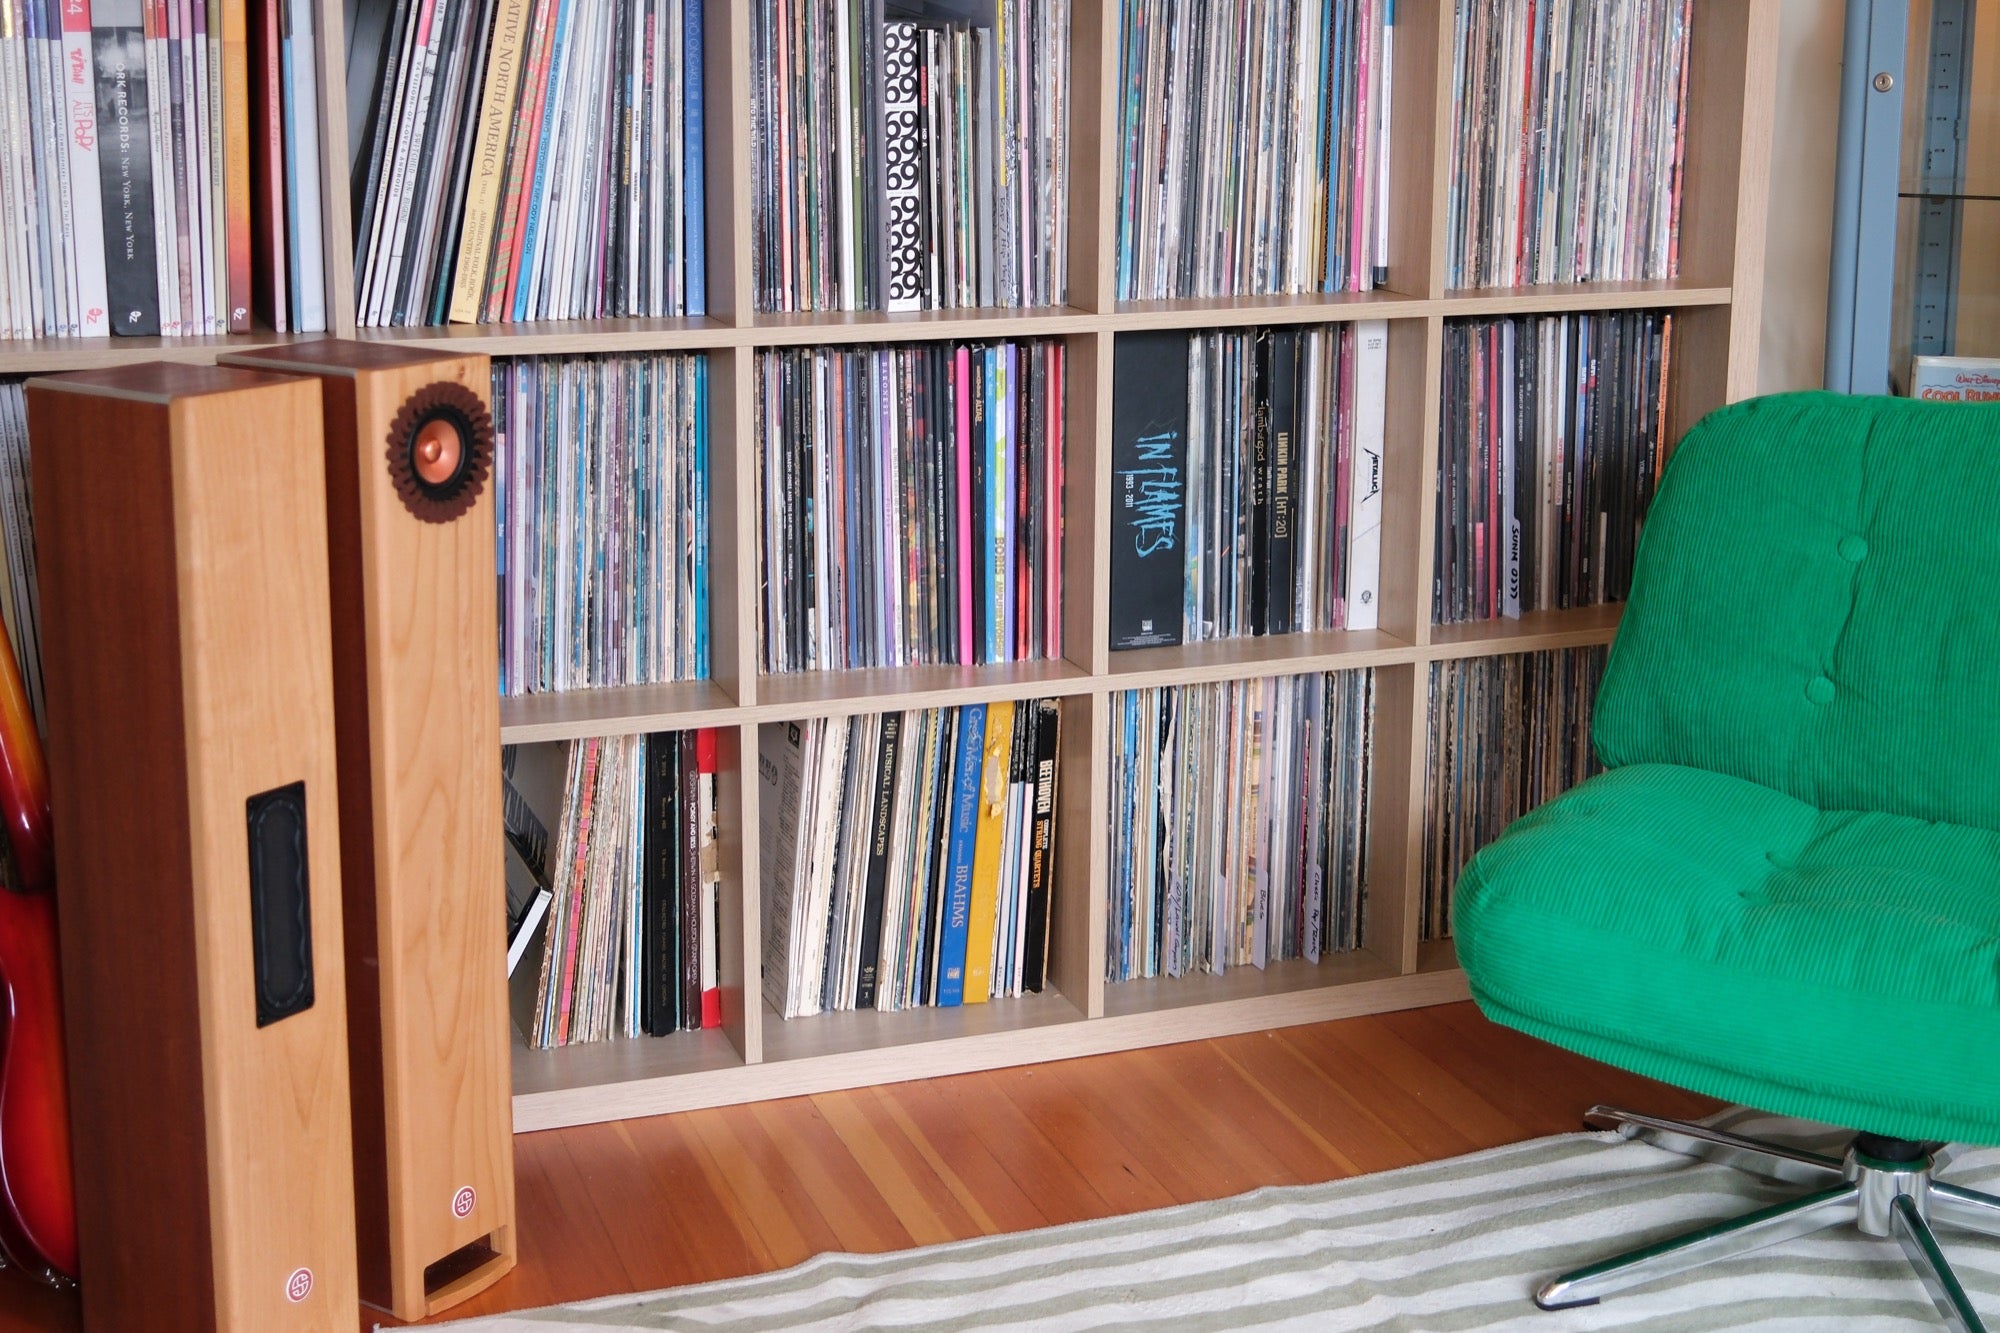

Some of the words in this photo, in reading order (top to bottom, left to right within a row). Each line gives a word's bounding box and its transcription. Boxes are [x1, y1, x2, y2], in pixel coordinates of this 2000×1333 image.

[503, 0, 521, 44] ATIVE
[414, 61, 422, 72] V4
[552, 43, 562, 73] SERGE
[689, 39, 699, 86] ONGAKU
[115, 63, 127, 88] ORK
[493, 47, 514, 104] NORTH
[406, 112, 413, 122] OF
[543, 74, 559, 133] GAINSBOURG
[117, 91, 130, 154] RECORDS:
[402, 125, 411, 147] LOVE
[408, 133, 422, 174] SWITCHED
[481, 105, 504, 178] AMERICA
[537, 137, 548, 174] HISTOIRE
[121, 157, 130, 178] NEW
[536, 175, 543, 187] DE
[122, 180, 133, 209] YORK,
[530, 188, 542, 223] MELODY
[999, 197, 1008, 222] Rap
[124, 212, 133, 232] NEW
[126, 235, 135, 260] YORK
[525, 224, 536, 255] NELSON
[1276, 432, 1289, 465] LINKIN
[1125, 474, 1134, 489] 1993
[1256, 467, 1265, 505] wrath
[1276, 467, 1289, 494] PARK
[1361, 446, 1382, 504] METALLICA
[1115, 463, 1183, 559] FLAMES
[1125, 494, 1134, 508] 2011
[1274, 496, 1290, 539] [HT:20]
[995, 537, 1006, 575] BORIS
[882, 743, 894, 789] MUSICAL
[1036, 759, 1054, 815] BEETHOVEN
[690, 802, 698, 824] PORGY
[690, 823, 698, 837] AND
[876, 790, 889, 857] LANDSCAPES
[959, 793, 975, 835] Music
[690, 837, 698, 849] BESS
[1034, 820, 1044, 850] STRING
[1033, 850, 1042, 889] QUARTETS
[951, 865, 969, 929] BRAHMS
